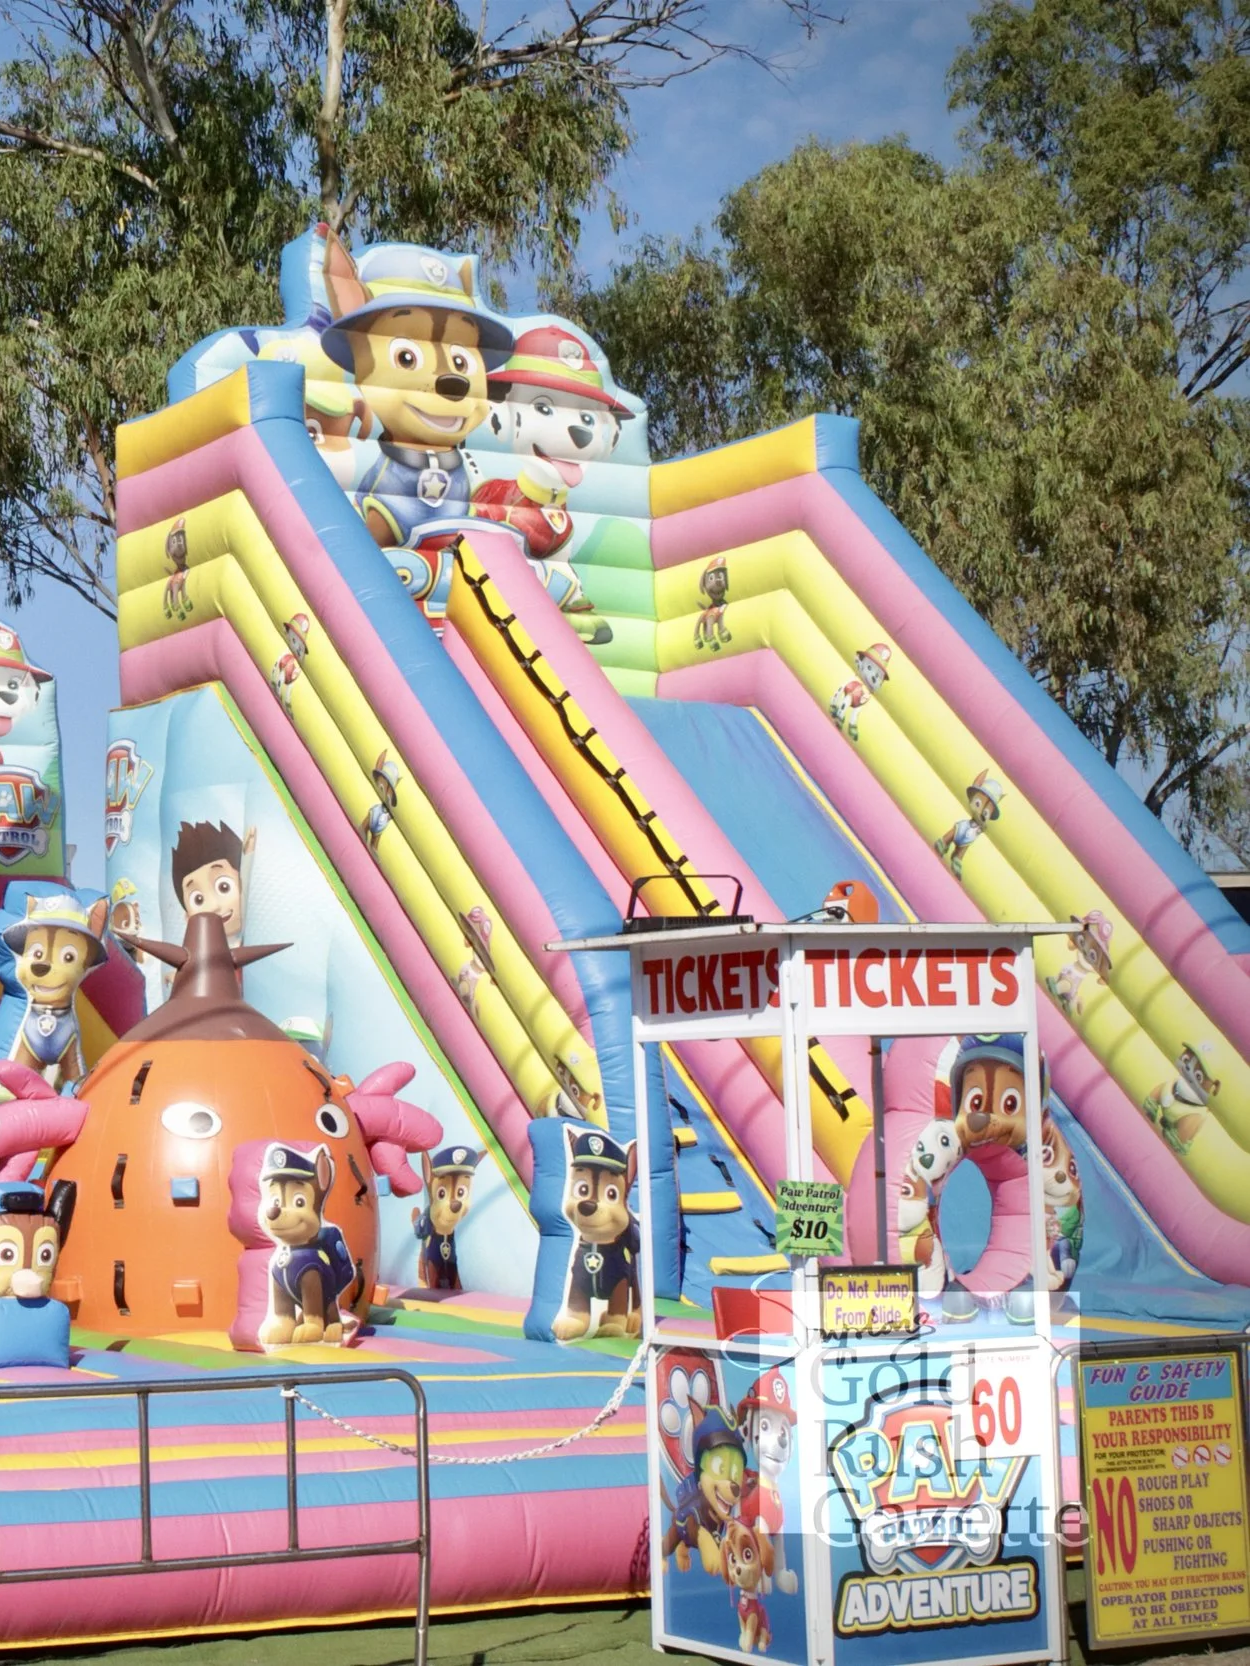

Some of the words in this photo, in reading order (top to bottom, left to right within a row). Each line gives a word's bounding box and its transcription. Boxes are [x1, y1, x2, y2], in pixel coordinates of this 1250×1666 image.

[642, 947, 780, 1015] TICKETS
[804, 947, 1020, 1008] TICKETS
[780, 1186, 804, 1197] Paw
[806, 1188, 841, 1200] Patrol
[782, 1200, 839, 1213] Adventure
[790, 1217, 828, 1240] $10
[827, 1282, 843, 1299] Do
[848, 1279, 868, 1298] Not
[874, 1281, 908, 1299] Jump
[835, 1307, 866, 1325] From
[871, 1305, 902, 1325] Slide
[1090, 1366, 1126, 1384] FUN
[1137, 1365, 1150, 1382] &
[1160, 1360, 1226, 1380] SAFETY
[1129, 1382, 1190, 1401] GUIDE
[971, 1376, 1022, 1447] 60
[1108, 1407, 1167, 1427] PARENTS
[1170, 1404, 1199, 1421] THIS
[1203, 1403, 1214, 1420] IS
[1092, 1431, 1128, 1449] YOUR
[1131, 1423, 1232, 1447] RESPONSIBILITY
[833, 1420, 1021, 1514] PAW
[1138, 1496, 1175, 1513] SHOES
[1178, 1495, 1194, 1510] OR
[883, 1516, 980, 1544] PATROL
[1092, 1476, 1137, 1577] NO
[1137, 1475, 1177, 1492] ROUGH
[1181, 1472, 1210, 1489] PLAY
[1153, 1515, 1191, 1532] SHARP
[1193, 1511, 1242, 1529] OBJECTS
[1143, 1537, 1194, 1555] PUSHING
[1196, 1535, 1212, 1550] OR
[1173, 1552, 1228, 1571] FIGHTING
[1135, 1580, 1150, 1589] YOU
[1151, 1578, 1167, 1588] MAY
[1170, 1576, 1184, 1586] GET
[1186, 1573, 1219, 1585] FRICTION
[1221, 1571, 1246, 1581] BURNS
[841, 1569, 1033, 1627] ADVENTURE
[1101, 1591, 1167, 1607] OPERATOR
[1171, 1584, 1244, 1601] DIRECTIONS
[1130, 1606, 1146, 1617] TO
[1150, 1604, 1165, 1615] BE
[1169, 1599, 1219, 1613] OBEYED
[1132, 1619, 1147, 1629] AT
[1153, 1616, 1176, 1628] ALL
[1180, 1611, 1218, 1625] TIMES
